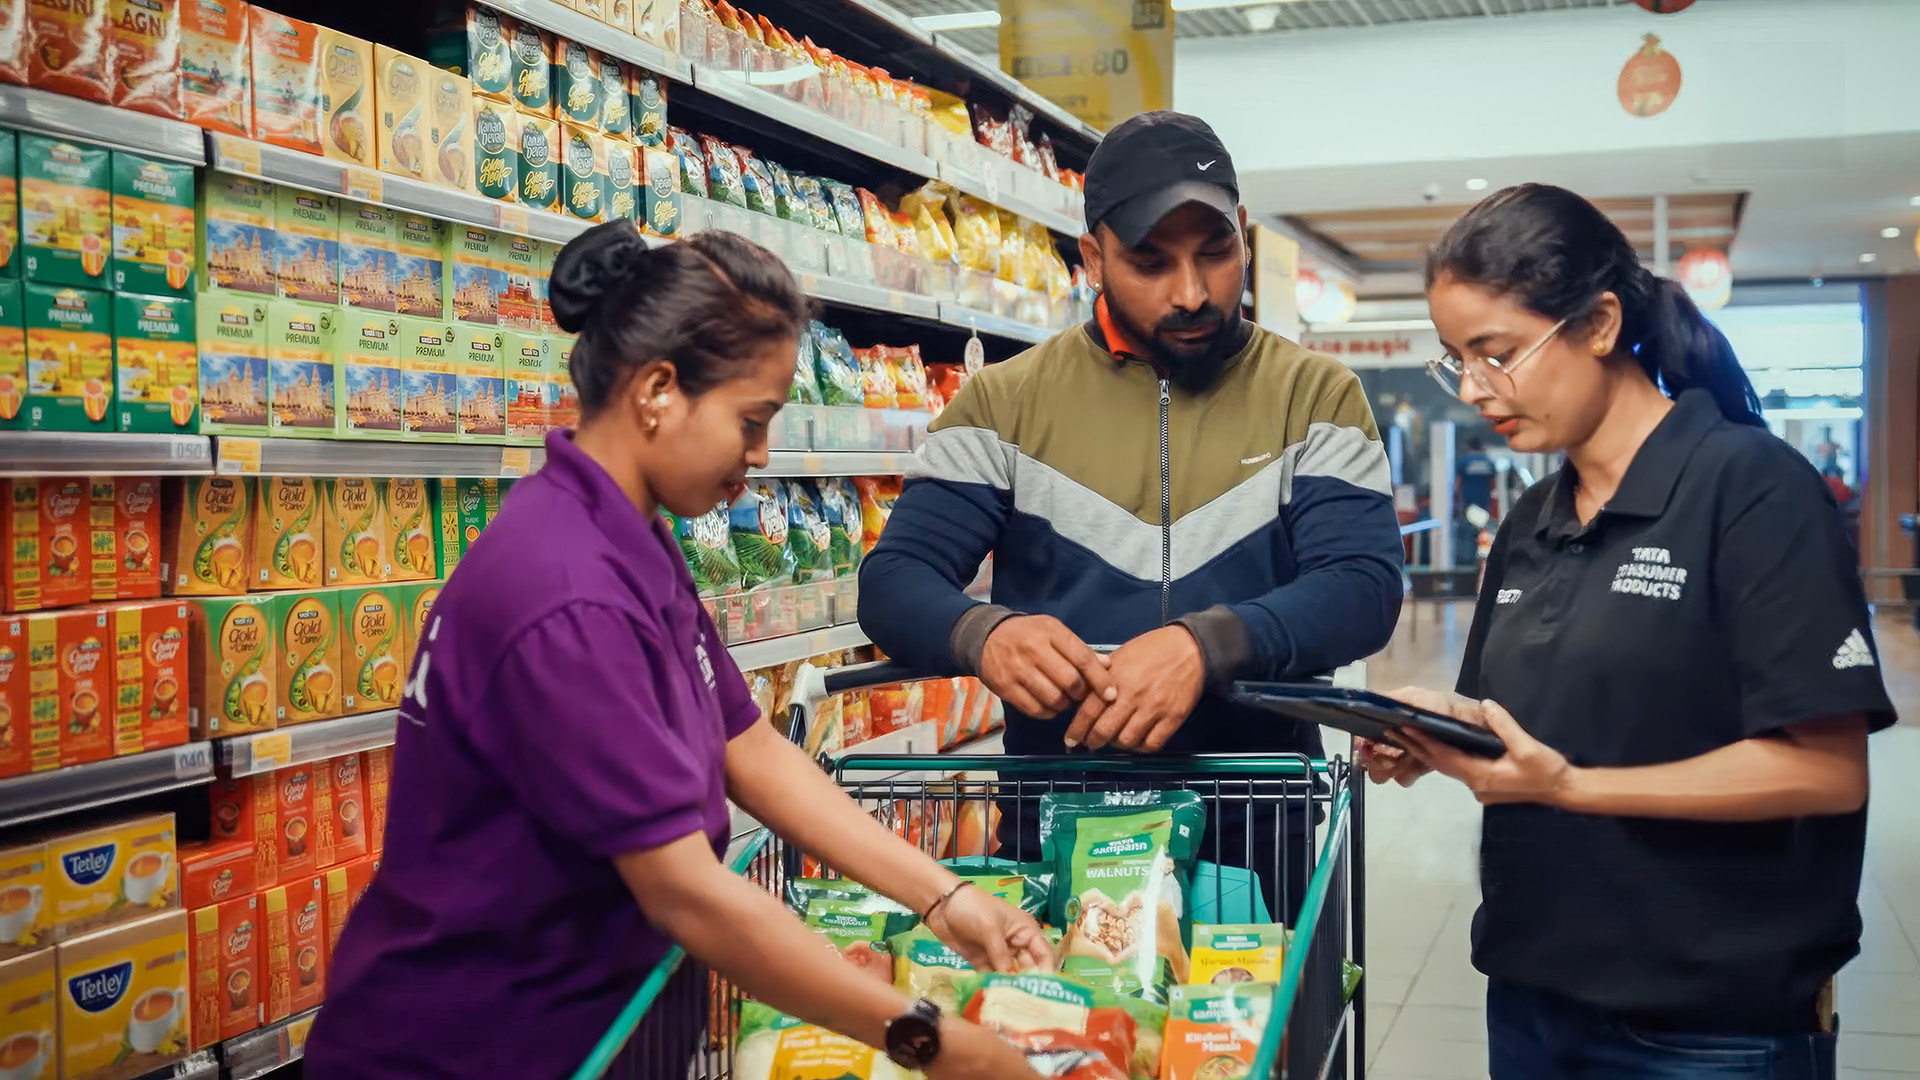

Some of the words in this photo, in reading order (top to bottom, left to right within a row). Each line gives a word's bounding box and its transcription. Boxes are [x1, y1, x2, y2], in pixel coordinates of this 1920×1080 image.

[216, 326, 253, 339] PREMIUM
[69, 852, 110, 874] Tetley
[1086, 866, 1149, 879] WALNUTS
[77, 972, 123, 1000] Tetley
